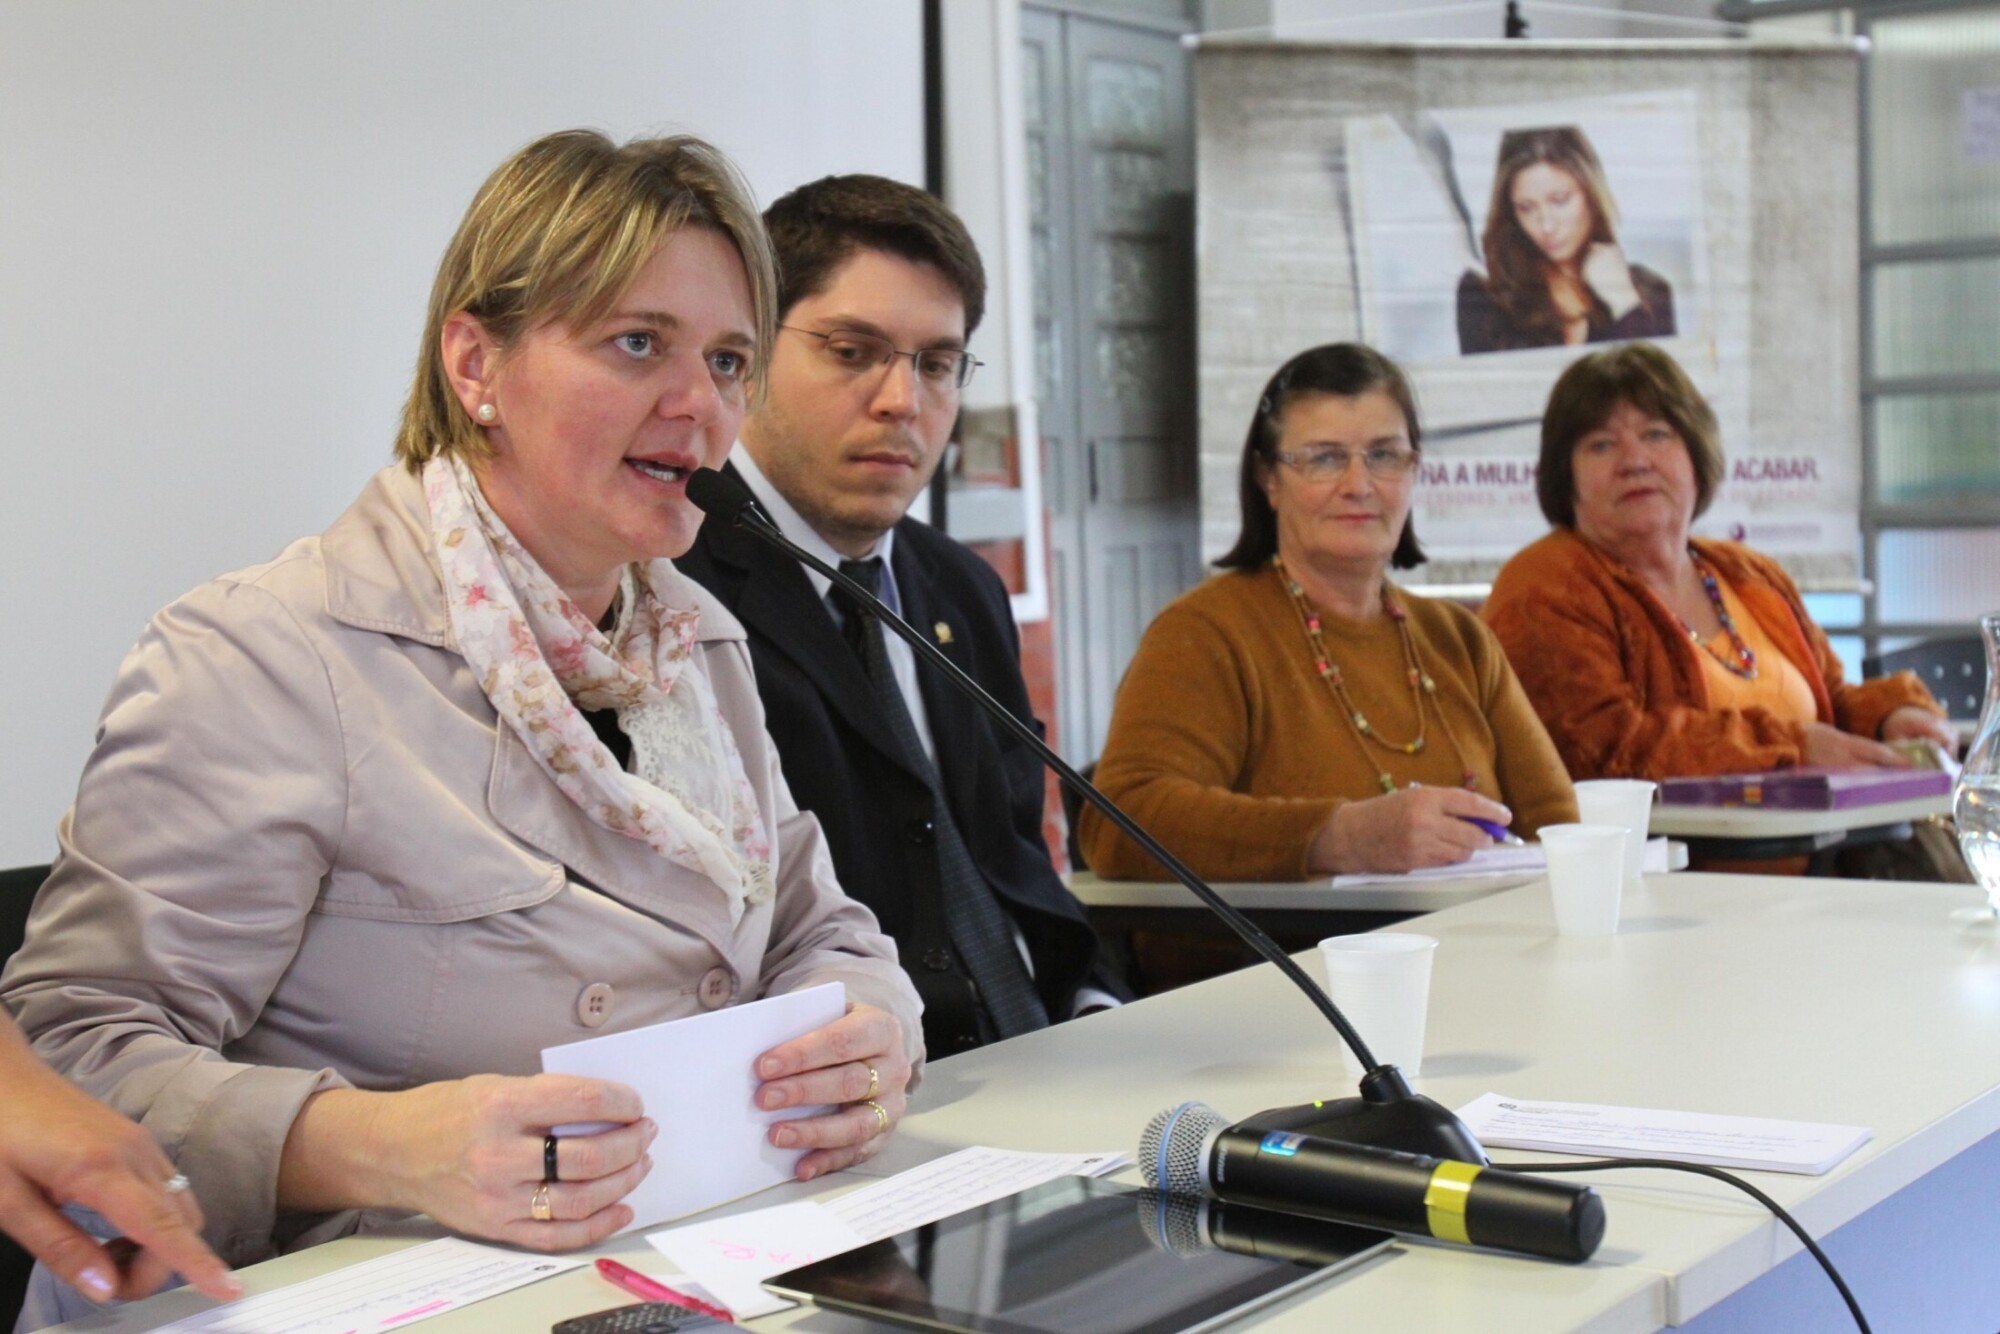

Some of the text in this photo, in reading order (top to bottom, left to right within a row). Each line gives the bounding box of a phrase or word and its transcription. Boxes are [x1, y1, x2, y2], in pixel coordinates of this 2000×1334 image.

[1418, 463, 1449, 486] RA
[1455, 463, 1469, 485] A
[1476, 462, 1540, 486] MULH
